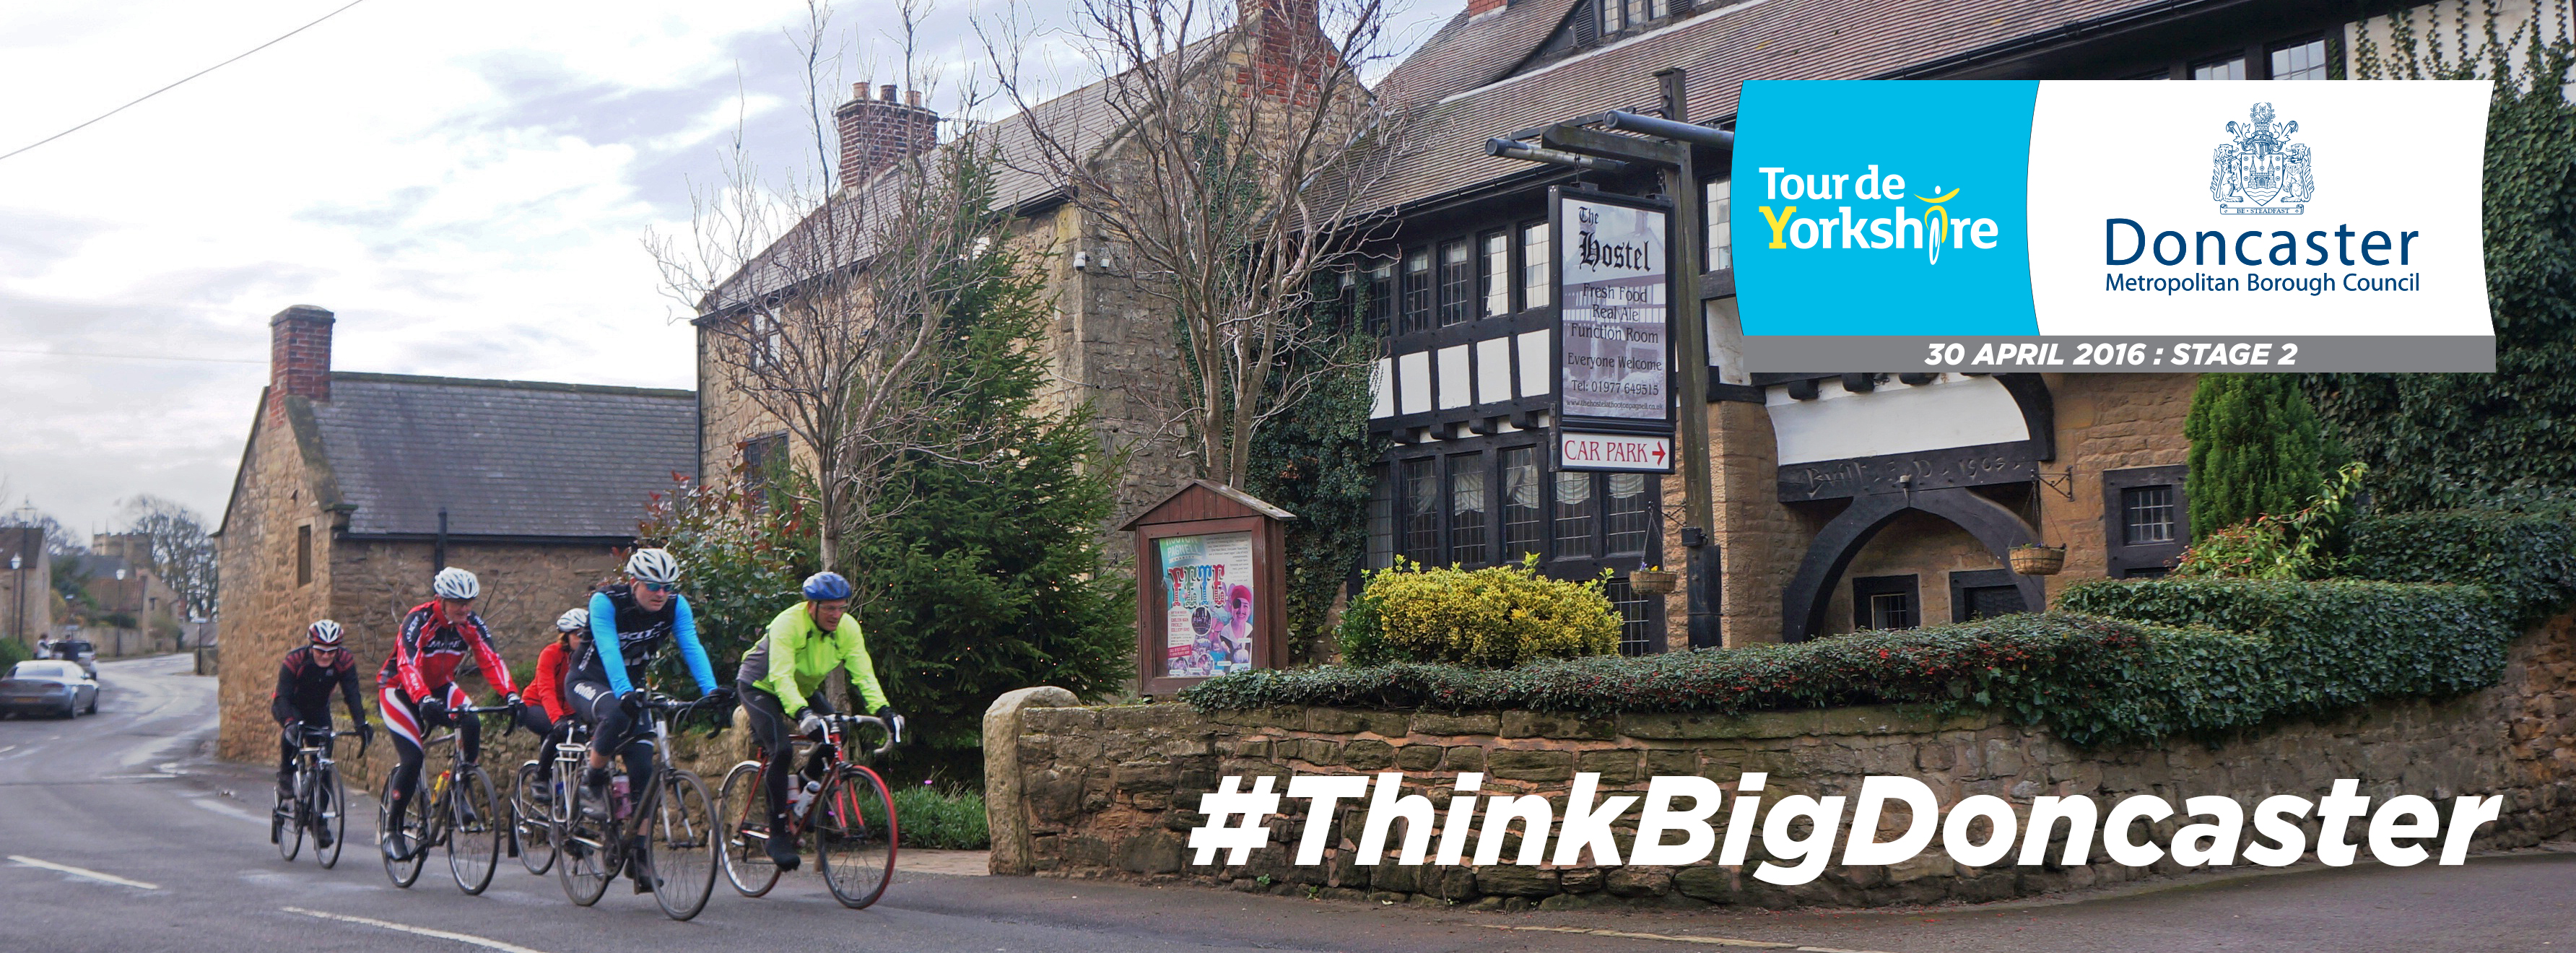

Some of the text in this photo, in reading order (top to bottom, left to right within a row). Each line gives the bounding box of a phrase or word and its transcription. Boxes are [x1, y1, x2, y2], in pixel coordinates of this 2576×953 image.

[1578, 206, 1599, 226] The
[1579, 230, 1651, 272] Hostel
[1583, 283, 1648, 303] Fresh Food
[1592, 304, 1639, 322] Real Ale
[1571, 323, 1659, 344] Function Room
[1567, 352, 1662, 371] Everyone Welcome
[1571, 380, 1659, 396] Tel: 01977 649515
[1565, 440, 1648, 463] CAR PARK
[1168, 564, 1226, 608] FETE
